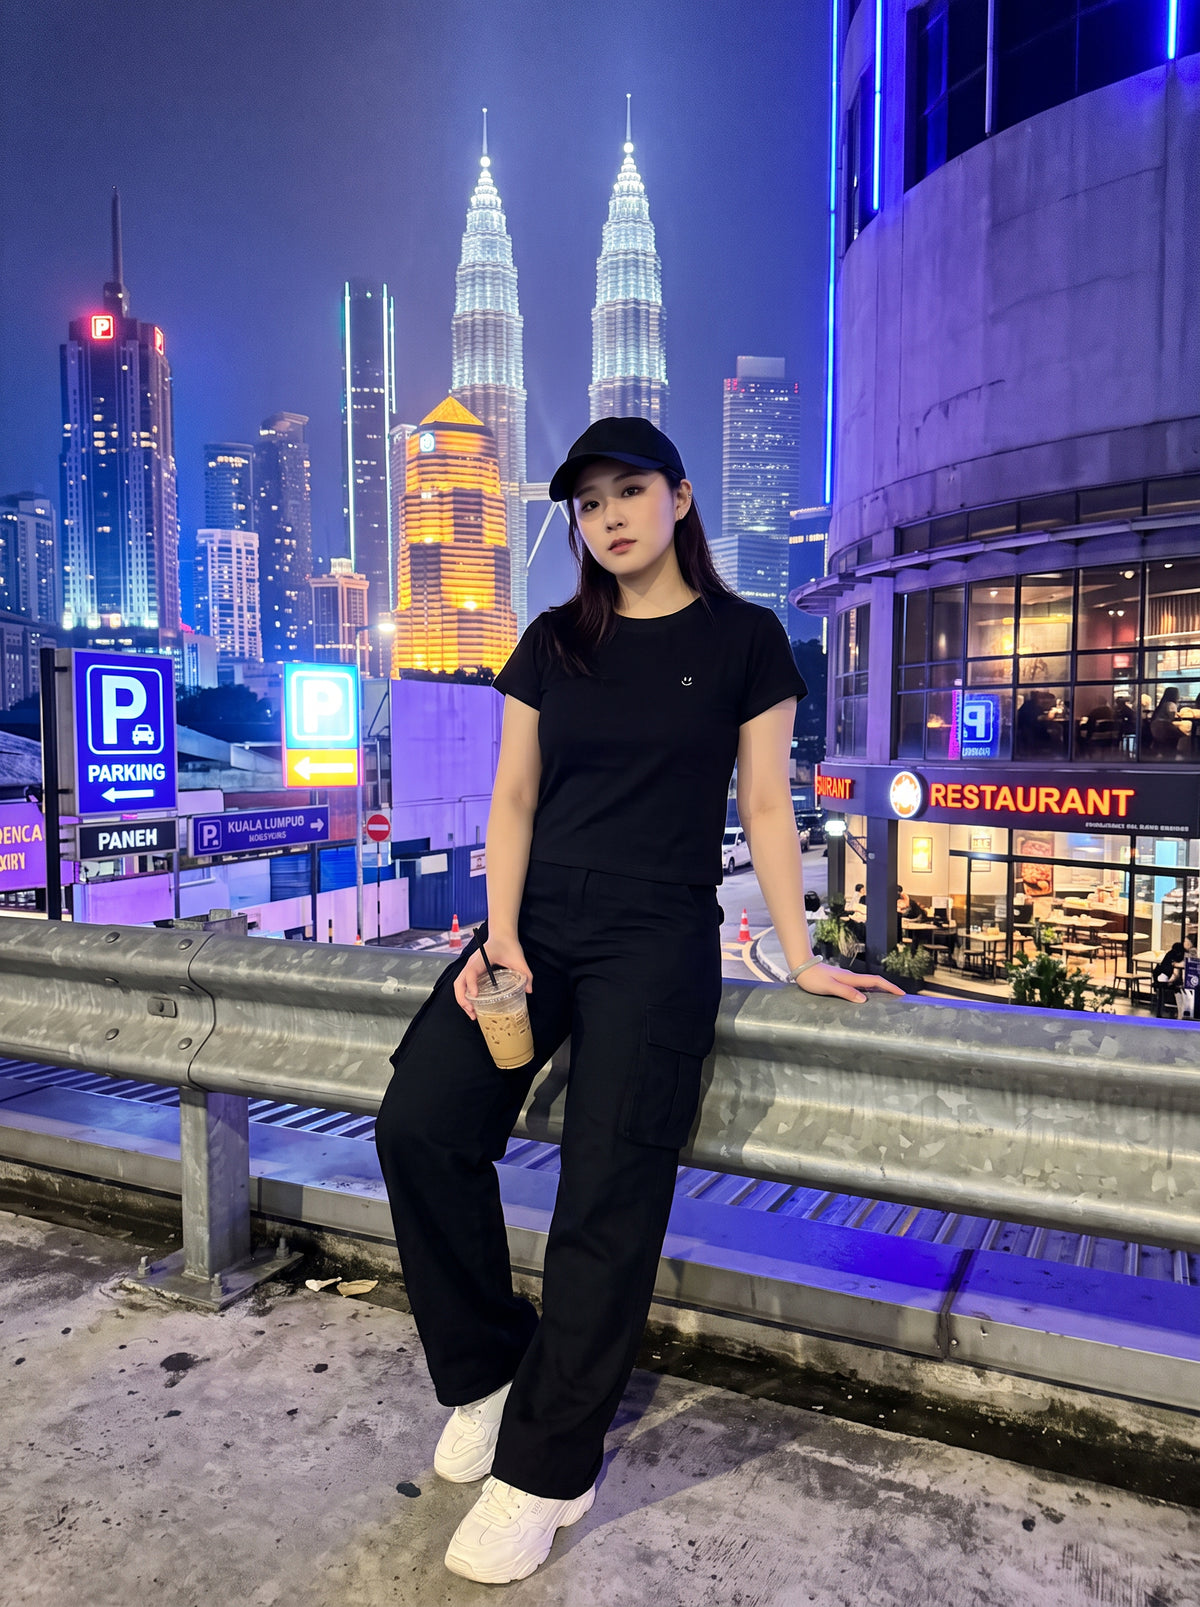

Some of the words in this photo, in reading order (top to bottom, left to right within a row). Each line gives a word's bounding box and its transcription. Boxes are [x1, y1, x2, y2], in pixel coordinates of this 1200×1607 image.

[96, 319, 110, 337] P
[102, 674, 147, 745] P
[302, 679, 343, 734] P
[88, 763, 166, 783] PARKING
[930, 783, 1135, 817] RESTAURANT
[98, 828, 158, 851] PANEH
[203, 824, 217, 847] P
[228, 819, 262, 834] KUALA
